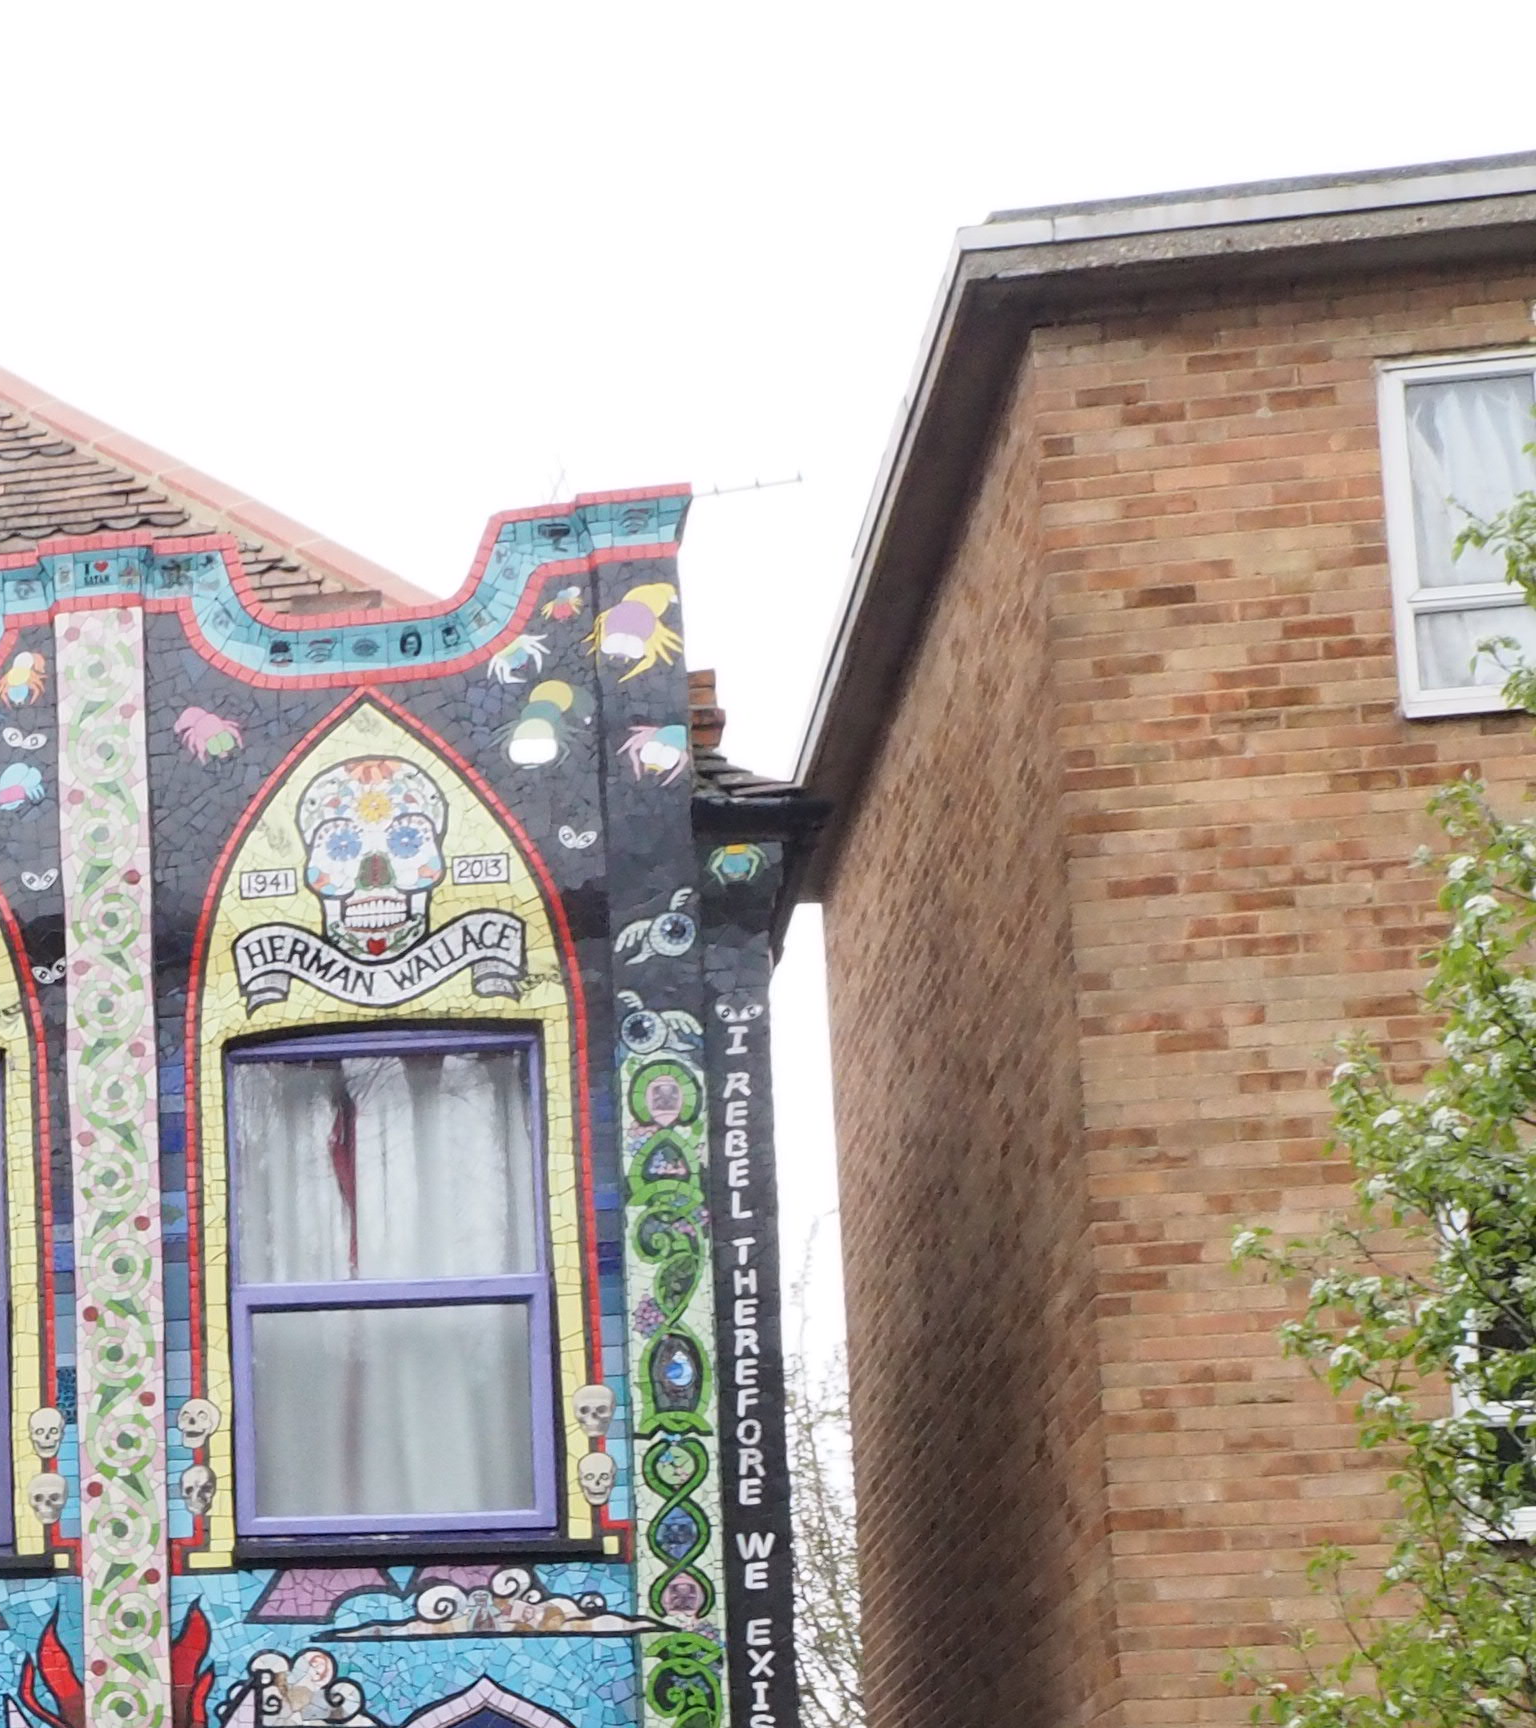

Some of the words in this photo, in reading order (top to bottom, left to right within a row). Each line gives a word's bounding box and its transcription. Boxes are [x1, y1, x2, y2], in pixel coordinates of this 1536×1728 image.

[247, 872, 289, 893] 1941
[456, 858, 504, 879] 2013
[243, 935, 376, 997] HERMAN
[386, 920, 520, 991] WALLACE
[725, 1026, 749, 1055] I
[722, 1072, 753, 1220] REBEL
[730, 1237, 765, 1506] THEREFORE
[735, 1532, 775, 1590] WE
